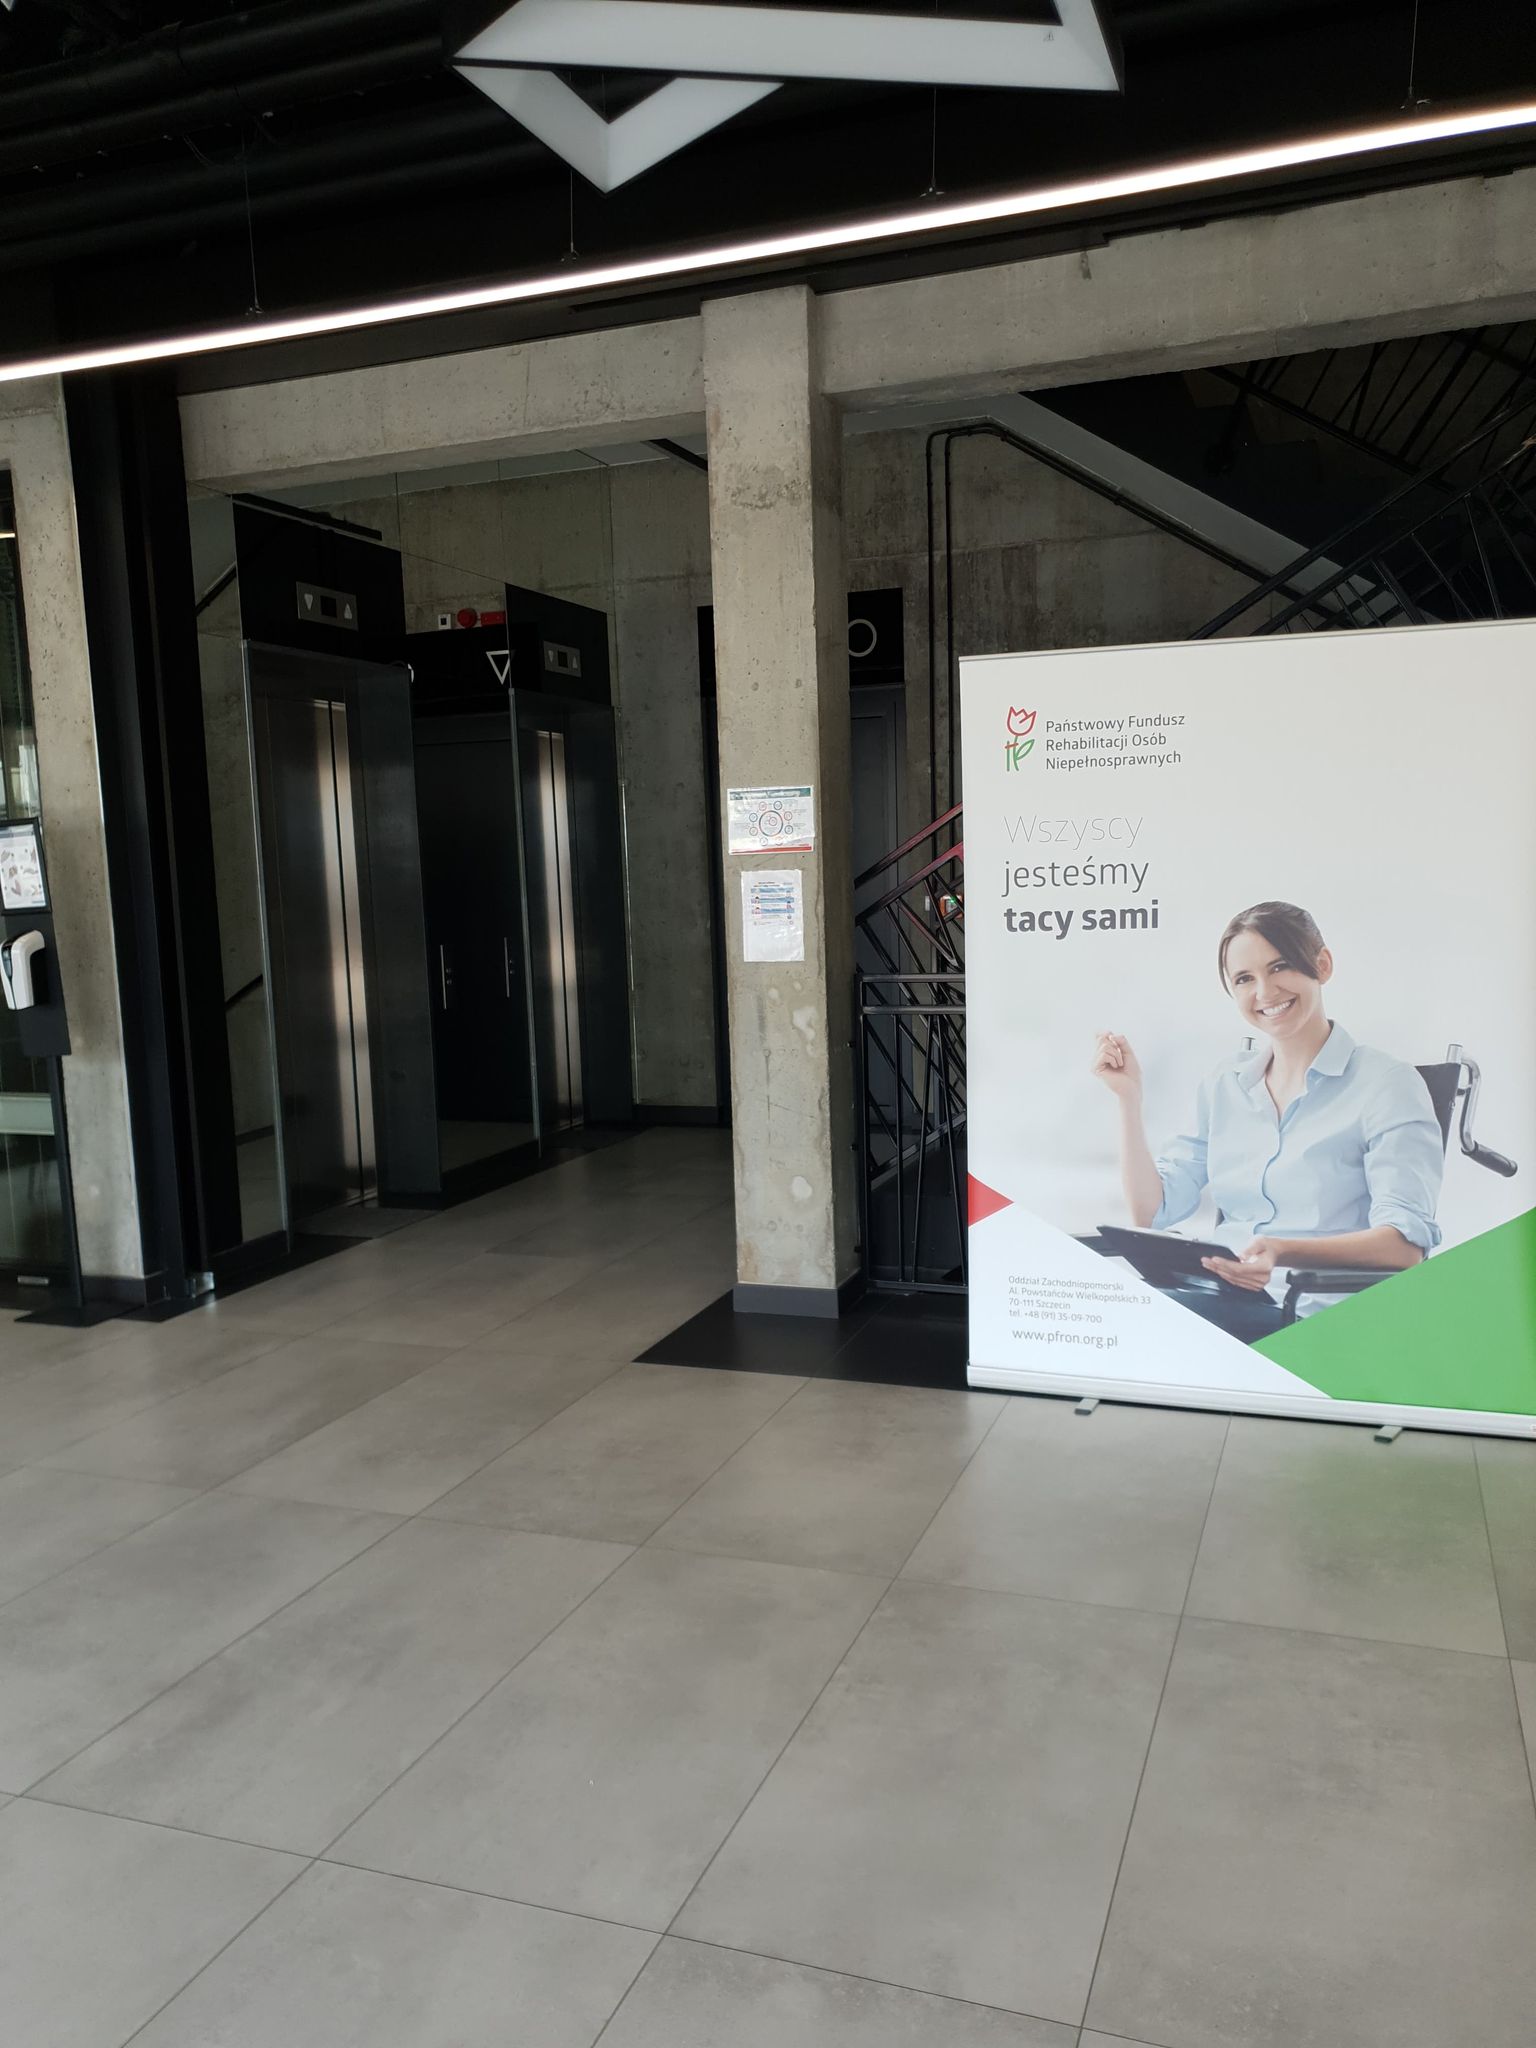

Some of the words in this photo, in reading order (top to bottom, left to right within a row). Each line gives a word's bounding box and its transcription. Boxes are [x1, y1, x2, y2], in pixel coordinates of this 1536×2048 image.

[1046, 719, 1125, 733] Państwowy
[1128, 714, 1185, 728] Fundusz
[1046, 736, 1128, 751] Rehabilitacji
[1132, 733, 1167, 747] Osób
[1046, 751, 1181, 771] Niepełnosprawnych
[1003, 814, 1143, 850] Wszyscy
[1001, 855, 1149, 897] jesteśmy
[1003, 907, 1074, 940] tacy
[1082, 899, 1159, 930] sami
[1008, 1275, 1040, 1285] Oddział
[1041, 1277, 1124, 1291] Zachodniopomorski
[1009, 1298, 1034, 1307] 70-111
[1036, 1300, 1071, 1309] Szczecin
[1021, 1287, 1074, 1299] Powstańców
[1075, 1291, 1139, 1303] Wielkopolskich
[1140, 1296, 1151, 1305] 33
[1024, 1311, 1039, 1319] +48
[1041, 1311, 1056, 1321] (91)
[1058, 1312, 1102, 1324] 35-09-700
[1012, 1328, 1118, 1349] www.pfron.org.pl
